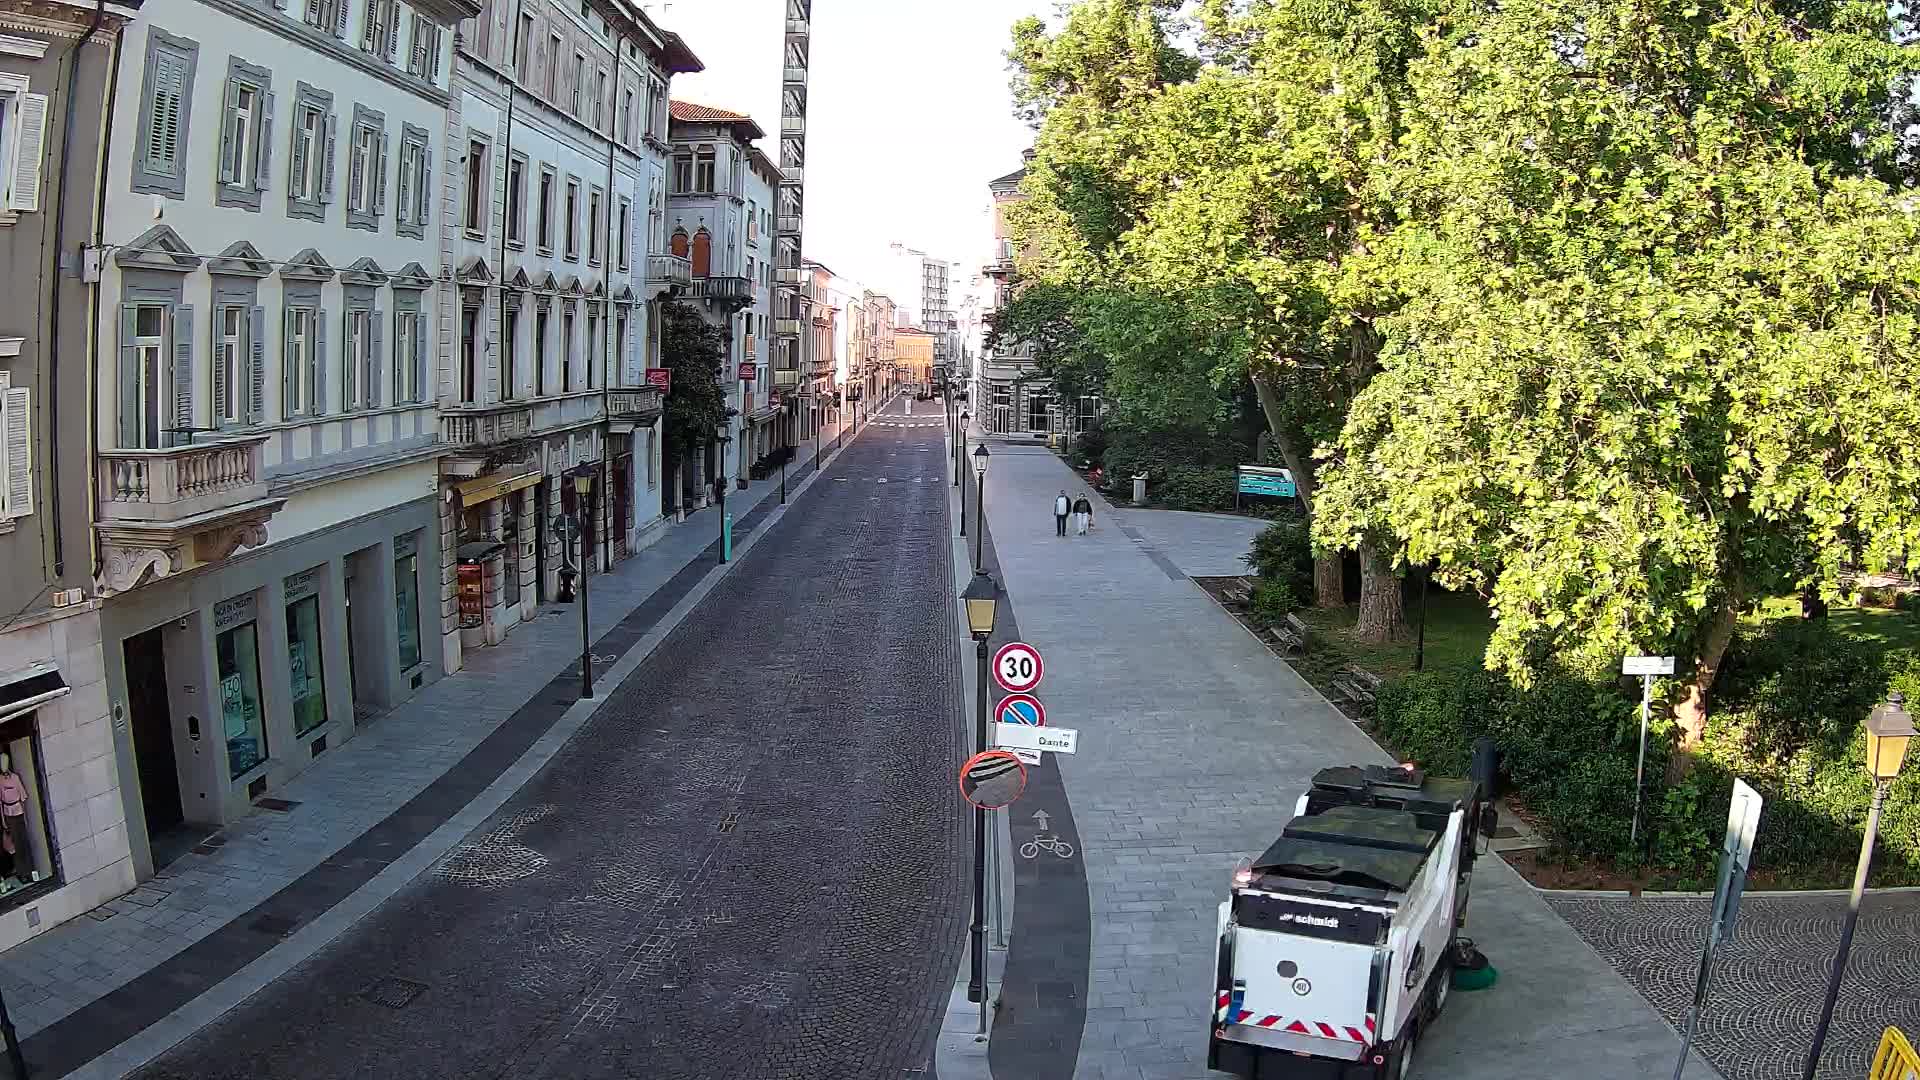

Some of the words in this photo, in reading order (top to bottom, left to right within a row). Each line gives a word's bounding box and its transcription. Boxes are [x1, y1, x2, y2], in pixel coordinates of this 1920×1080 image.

[1005, 657, 1032, 678] 30
[1039, 736, 1070, 748] Dante
[1295, 912, 1339, 928] schmidt
